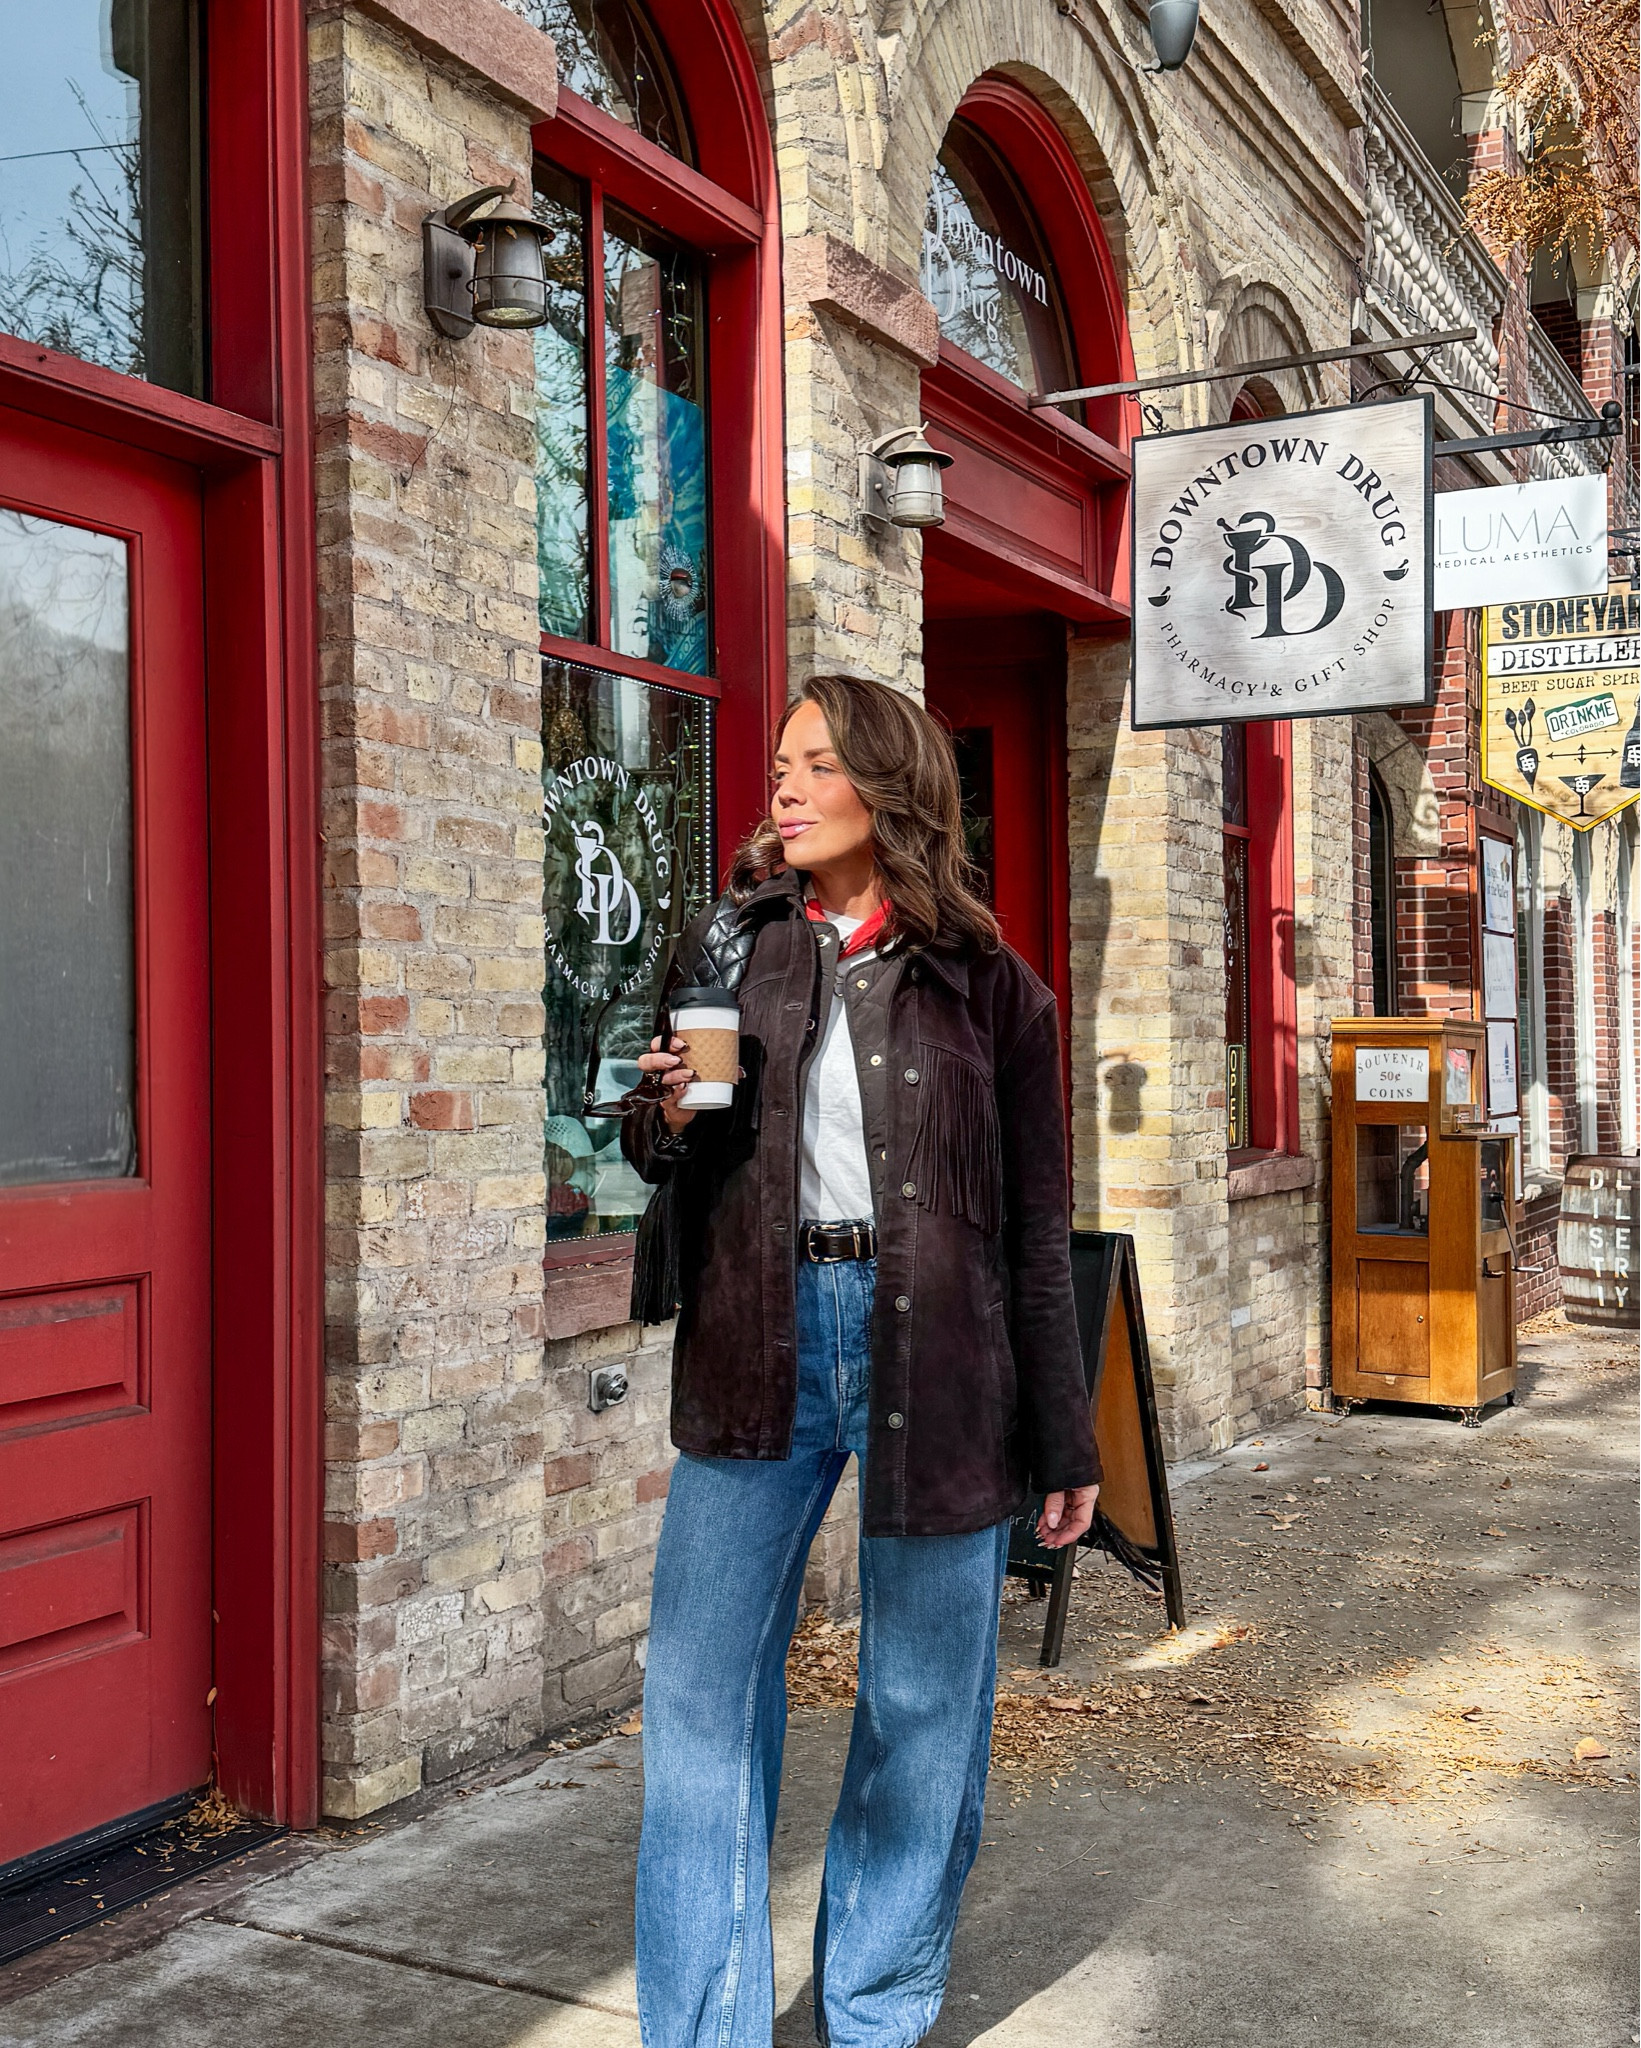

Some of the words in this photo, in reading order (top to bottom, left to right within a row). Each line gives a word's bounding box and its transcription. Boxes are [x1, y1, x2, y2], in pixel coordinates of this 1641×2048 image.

[1150, 437, 1330, 571] DOWNTOWN
[1336, 453, 1407, 548] DRUG
[1438, 504, 1581, 556] LUMA
[1433, 556, 1496, 570] MEDICAL
[1503, 544, 1594, 563] AESTHETICS
[1160, 621, 1259, 697] PHARMACY
[1269, 683, 1283, 697] &
[1294, 656, 1348, 693] GIFT
[1353, 597, 1395, 657] SHOP
[1501, 679, 1540, 695] BEET
[1546, 674, 1596, 692] SUGAR
[1549, 700, 1615, 733] DRINKME
[634, 787, 671, 879] DRUG
[602, 987, 611, 1001] &
[644, 921, 666, 972] SHOP
[1357, 1052, 1425, 1075] SOUVENIR
[1379, 1071, 1402, 1083] 50¢
[1229, 1049, 1237, 1145] OPEN
[1369, 1087, 1414, 1099] COINS
